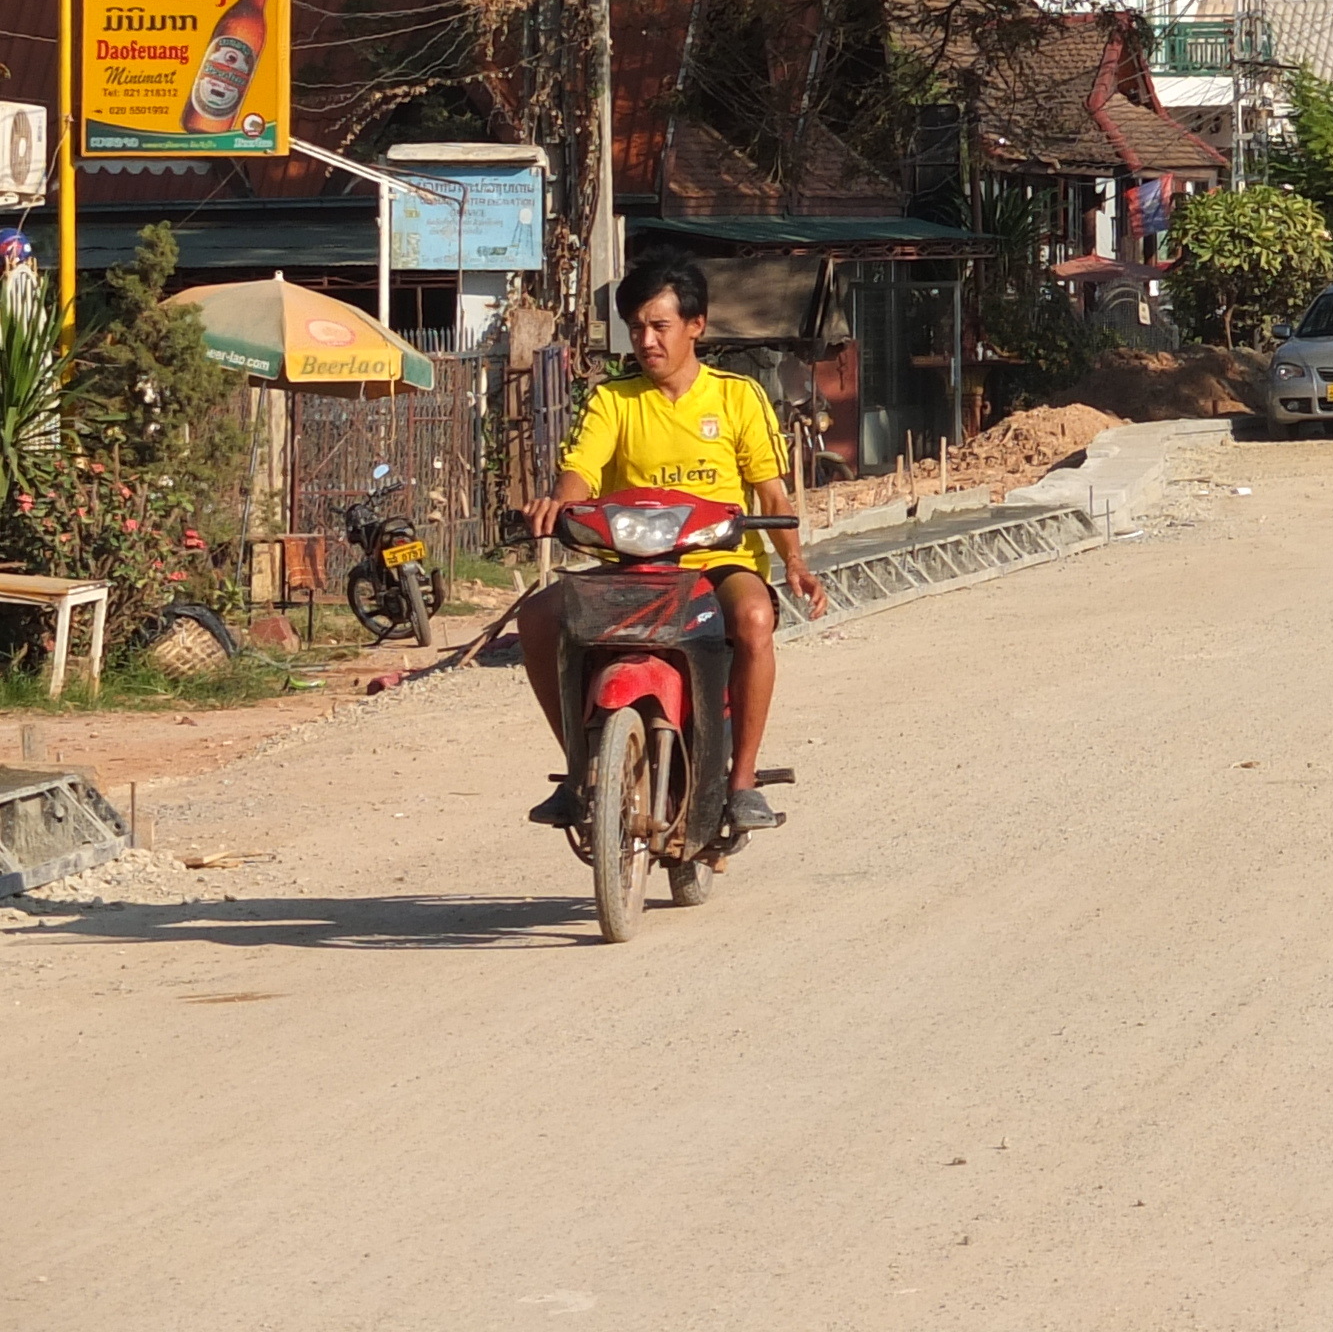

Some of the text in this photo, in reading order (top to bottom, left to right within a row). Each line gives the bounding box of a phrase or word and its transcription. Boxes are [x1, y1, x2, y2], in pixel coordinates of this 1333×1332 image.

[96, 39, 190, 65] Daofeuang
[104, 66, 177, 85] Minimart
[301, 353, 386, 376] Beerlao
